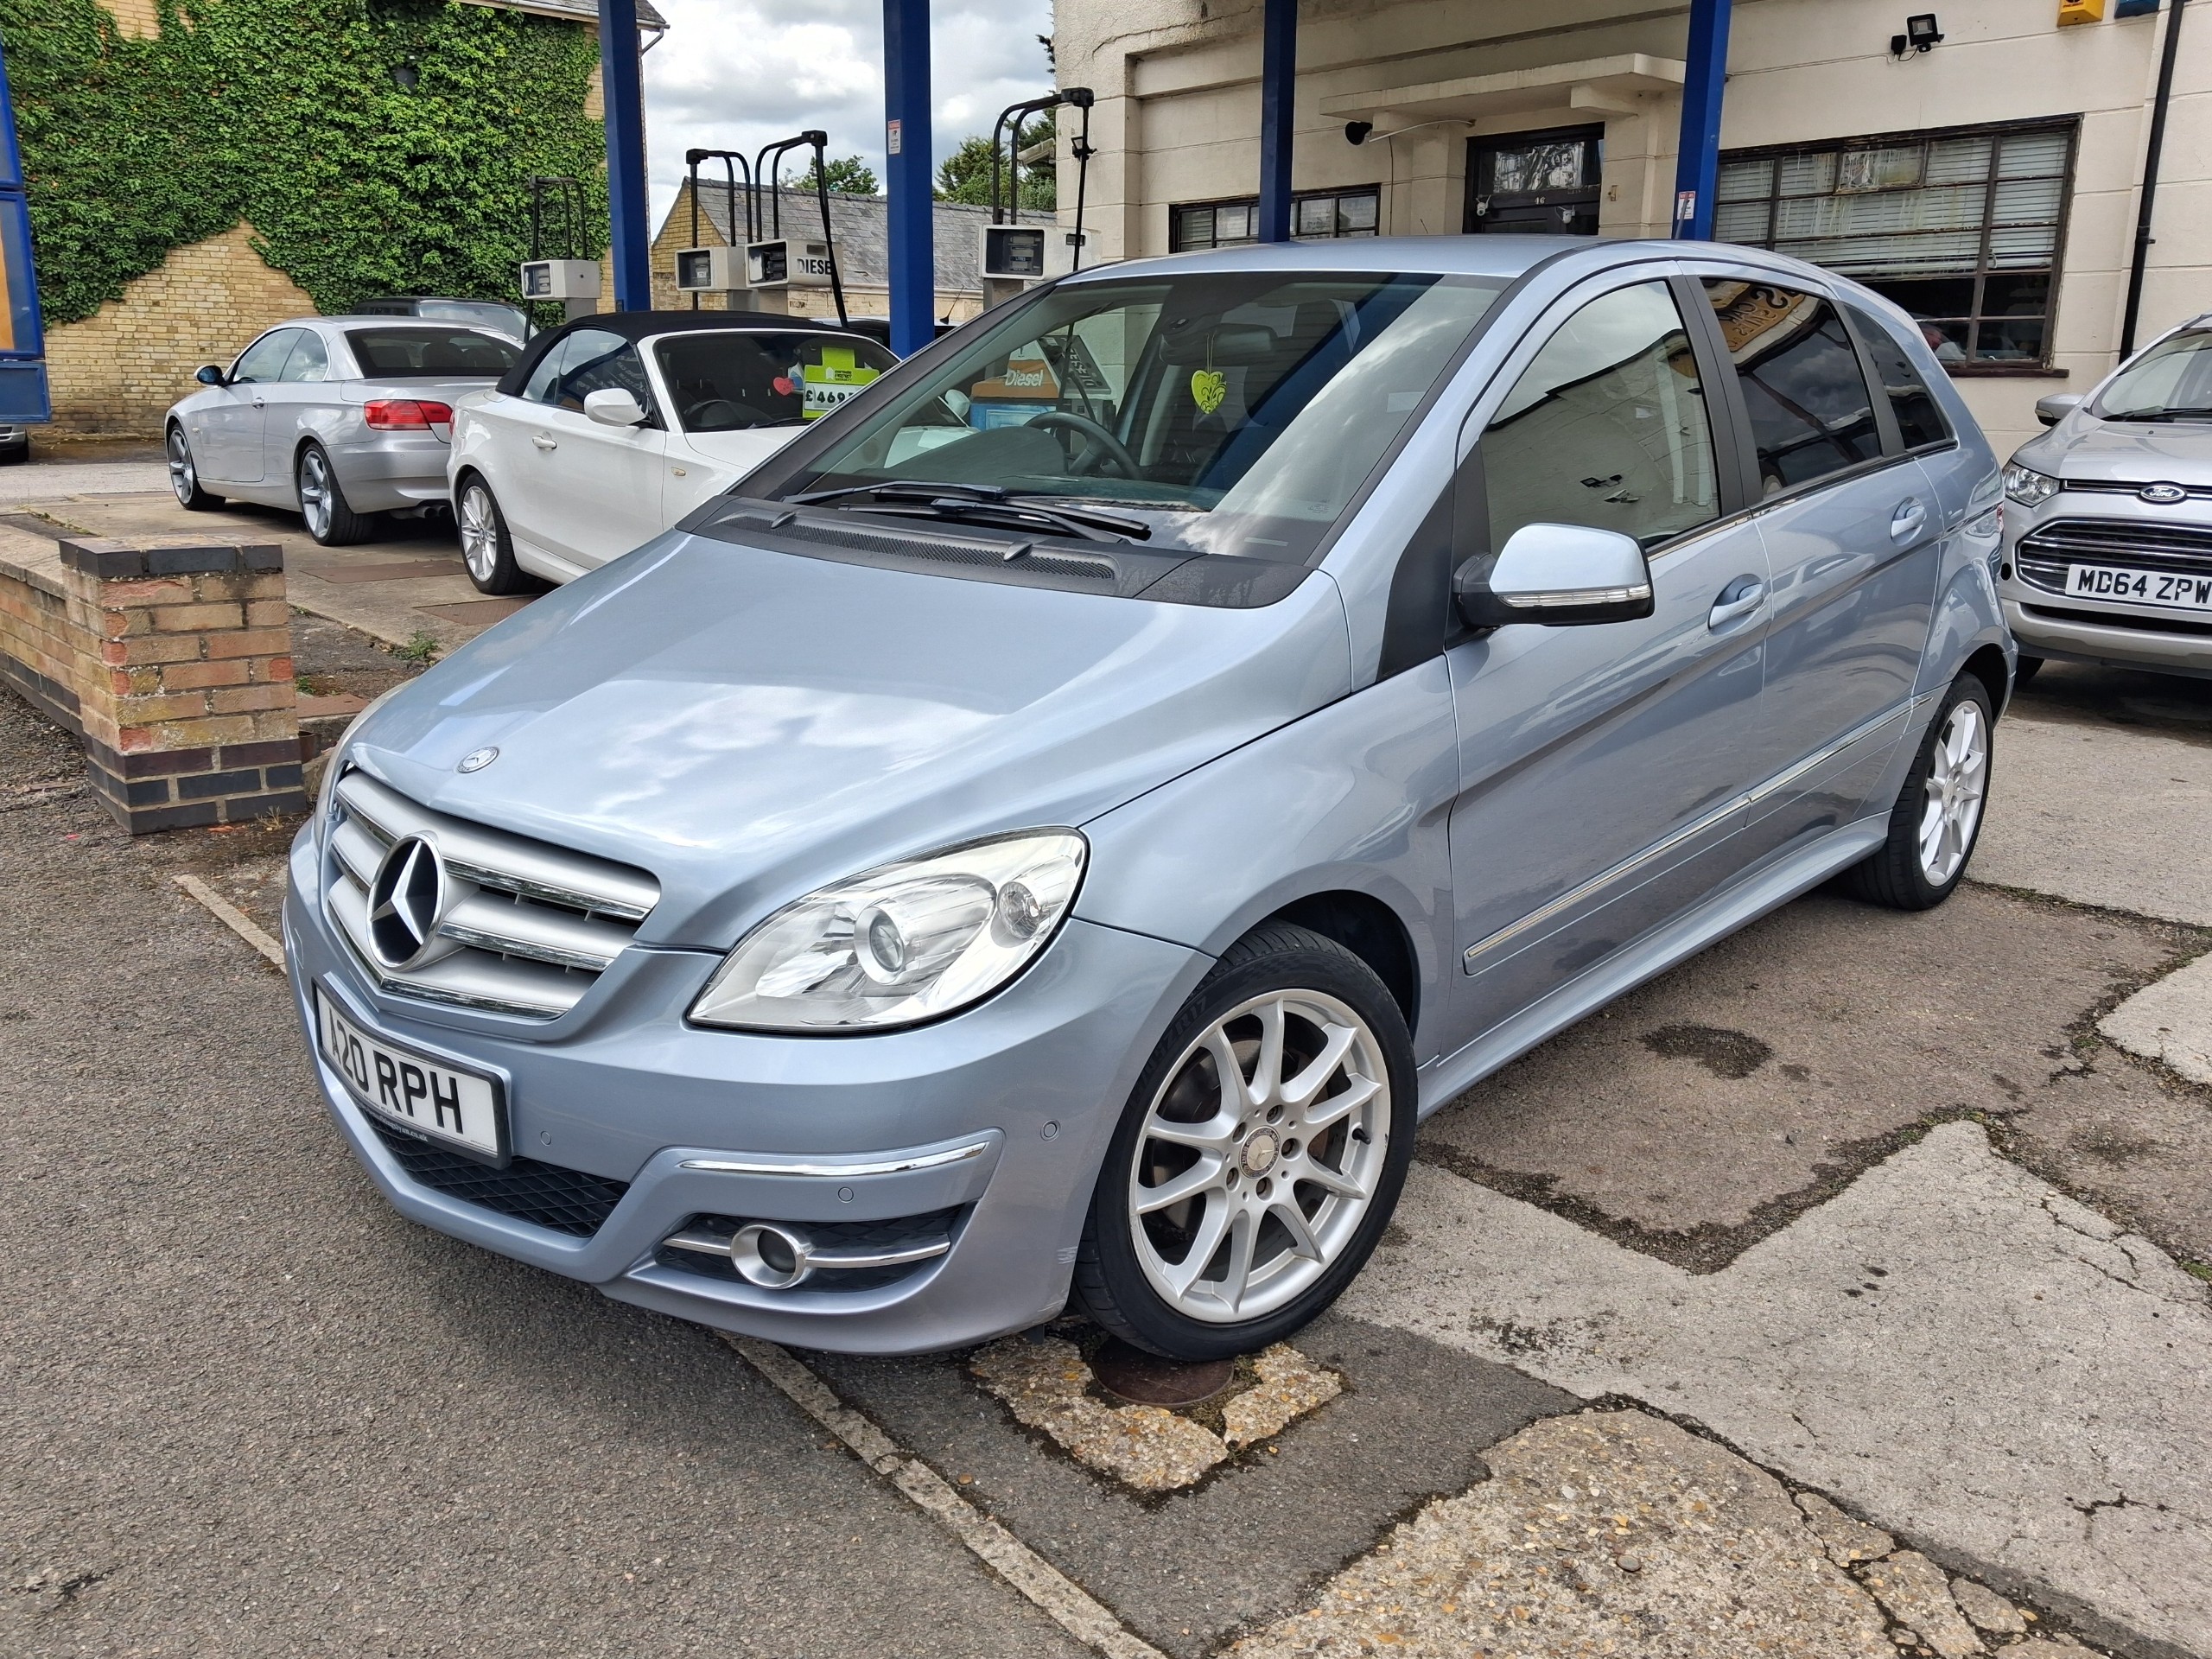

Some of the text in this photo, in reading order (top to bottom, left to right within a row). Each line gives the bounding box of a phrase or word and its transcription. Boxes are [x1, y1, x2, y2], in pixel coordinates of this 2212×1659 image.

[797, 258, 832, 275] DIESE
[1004, 369, 1044, 386] Diesel
[804, 390, 854, 404] £469
[2149, 487, 2175, 497] Ford
[2077, 569, 2212, 604] MD64 ZPW
[328, 1007, 370, 1093] A20
[372, 1049, 463, 1135] RPH
